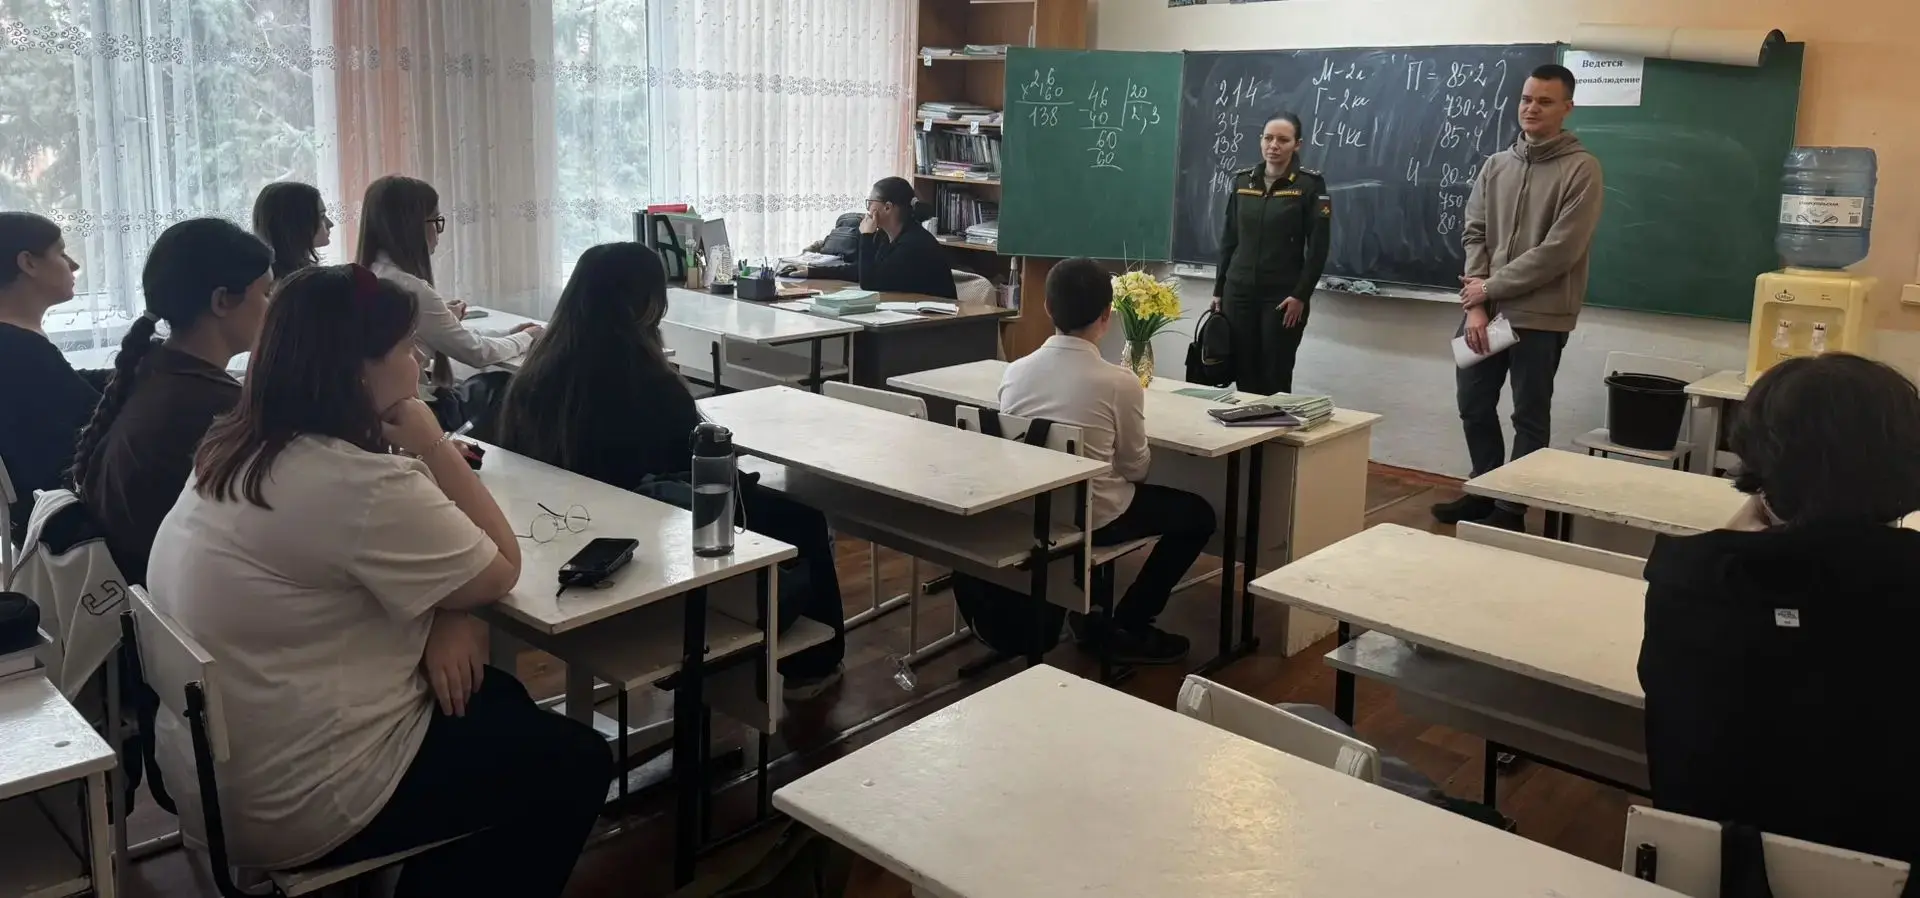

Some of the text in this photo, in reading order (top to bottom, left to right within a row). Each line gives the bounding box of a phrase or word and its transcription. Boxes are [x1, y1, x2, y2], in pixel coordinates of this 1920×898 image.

[1406, 60, 1424, 90] П
[1582, 60, 1623, 69] Ведется
[1088, 80, 1109, 111] 46
[1130, 84, 1148, 99] 20
[1028, 106, 1059, 127] 138
[1215, 112, 1240, 136] 34
[1096, 130, 1117, 149] 60
[1212, 133, 1244, 154] 138
